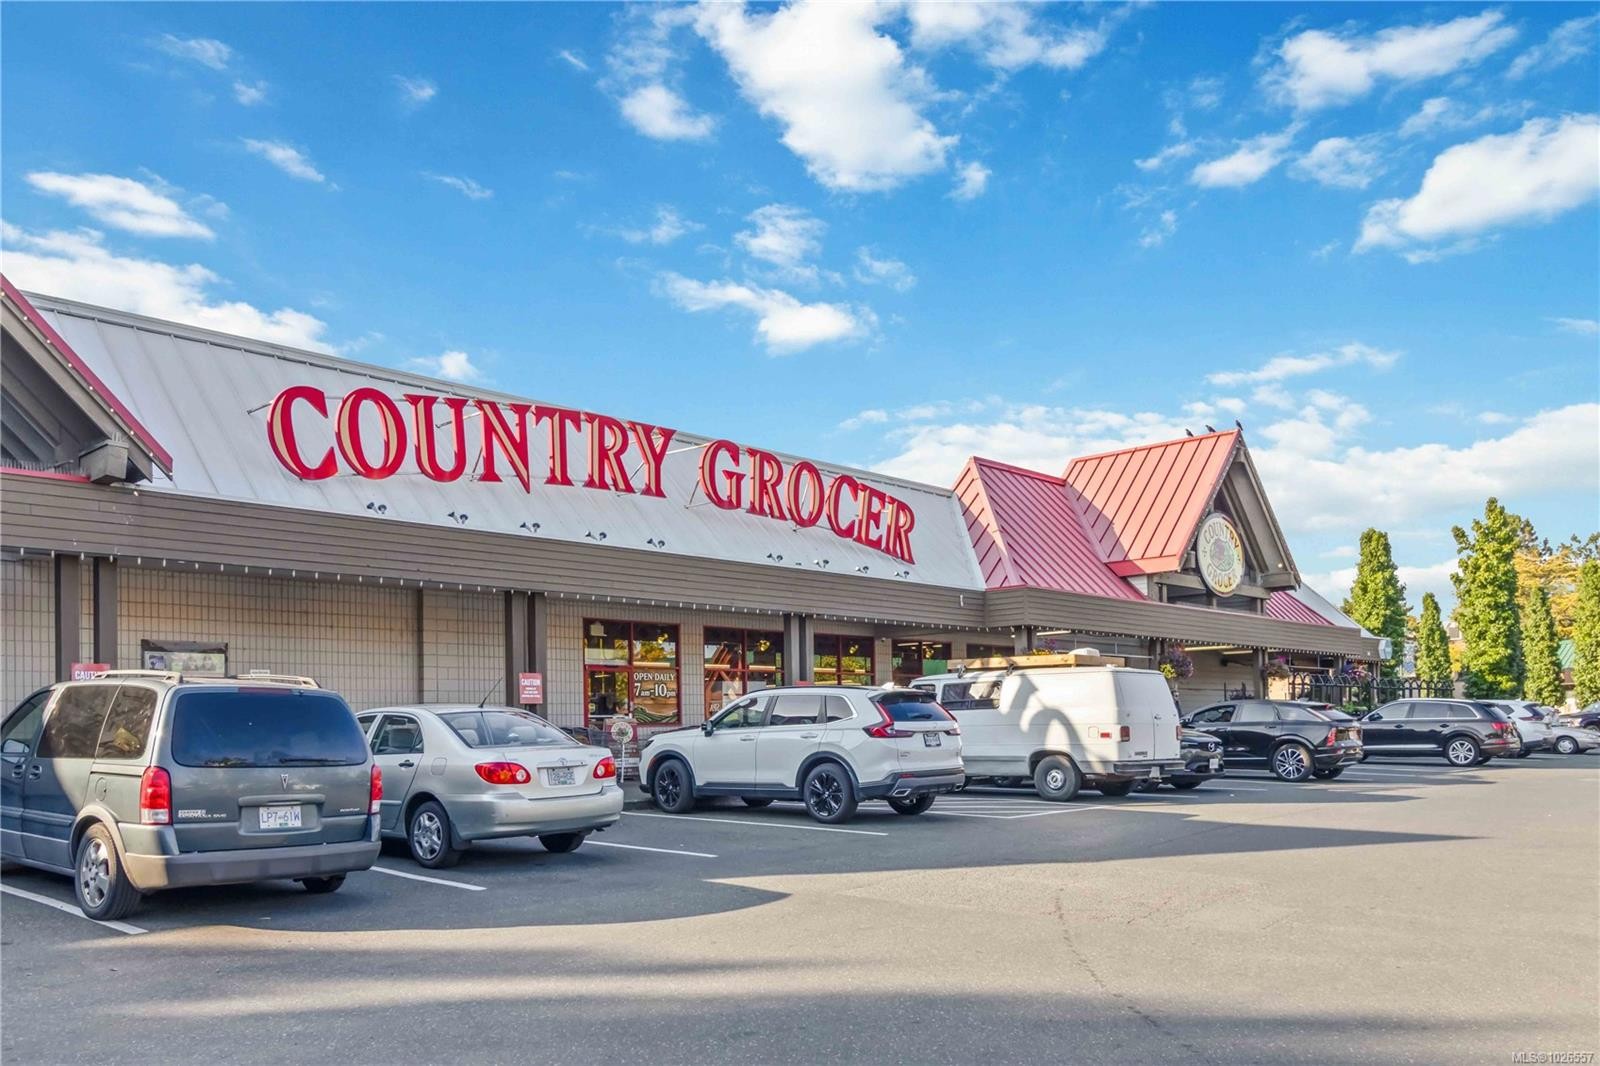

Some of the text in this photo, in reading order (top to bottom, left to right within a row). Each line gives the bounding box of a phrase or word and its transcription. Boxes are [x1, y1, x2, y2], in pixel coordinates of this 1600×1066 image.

[266, 385, 916, 565] COUNTRY GROCER
[1202, 521, 1241, 550] COUNTRY
[521, 678, 541, 686] CAUTION
[633, 672, 676, 681] OPEN DAILY
[634, 682, 677, 698] 7am-10pm
